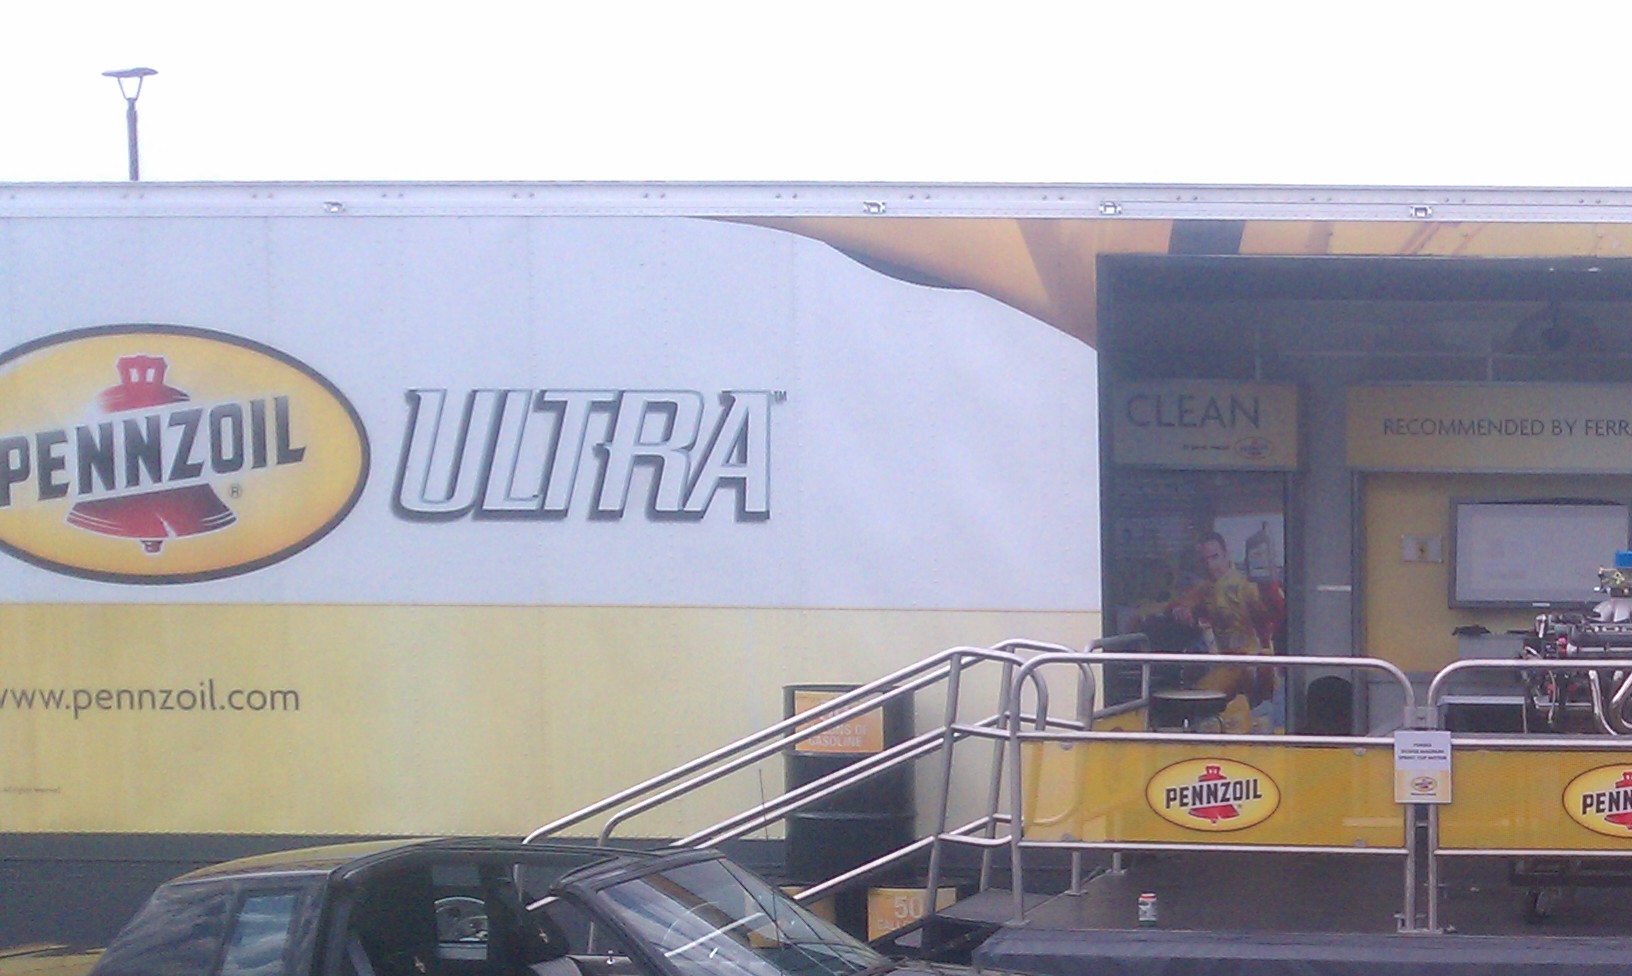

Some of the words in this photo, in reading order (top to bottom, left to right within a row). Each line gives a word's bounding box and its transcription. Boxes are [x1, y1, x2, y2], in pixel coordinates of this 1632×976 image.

[1127, 394, 1261, 428] CLEAN
[1383, 418, 1545, 437] RECOMMENDED
[1551, 419, 1577, 437] BY
[0, 396, 306, 507] PENNZOIL
[390, 389, 771, 521] ULTRA
[0, 679, 300, 720] ww.pennzoil.com
[1166, 779, 1262, 809] PENNZOIL
[895, 896, 923, 919] 50
